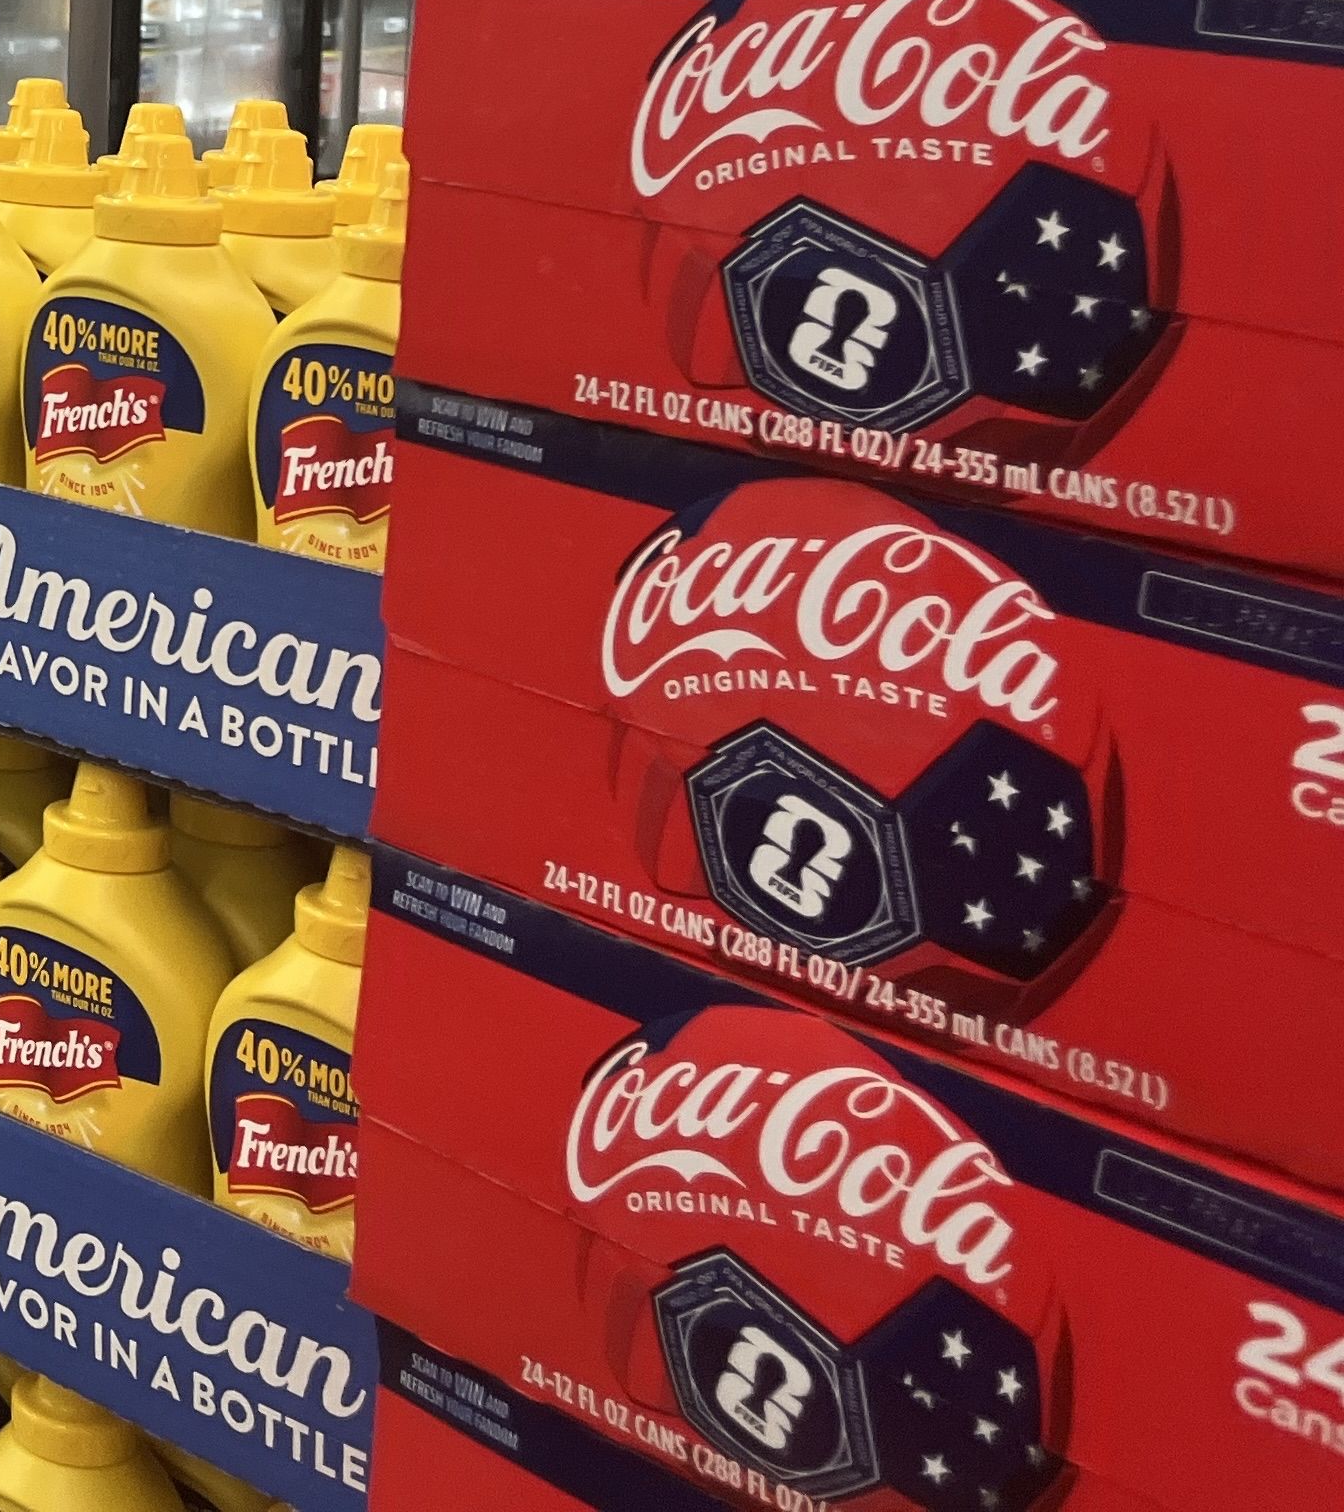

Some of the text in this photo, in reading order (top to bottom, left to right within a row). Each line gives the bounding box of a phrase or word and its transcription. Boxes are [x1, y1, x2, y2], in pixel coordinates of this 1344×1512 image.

[695, 136, 994, 192] ORIGINAL TASTE
[42, 310, 160, 358] 40% MORE
[808, 353, 845, 380] FIFA
[39, 389, 149, 442] French's
[573, 375, 633, 412] 24-12
[634, 383, 663, 417] FL
[666, 389, 693, 425] OZ
[696, 396, 754, 437] CANS
[759, 408, 815, 451] (288
[818, 418, 847, 453] FL
[912, 437, 998, 488] 24-355
[1003, 459, 1042, 496] mL
[1050, 467, 1119, 510] CANS
[1127, 480, 1199, 525] (8.52
[1205, 492, 1236, 535] L)
[599, 523, 1060, 724] Coca-Cola
[123, 675, 169, 726] IN
[177, 695, 210, 738] A
[663, 666, 949, 718] ORIGINAL TASTE
[566, 1040, 1017, 1287] Coca-Cola
[626, 1190, 907, 1270] ORIGINAL TASTE
[92, 1320, 140, 1382] IN
[149, 1354, 180, 1404] A
[191, 1374, 369, 1493] BOTTLE
